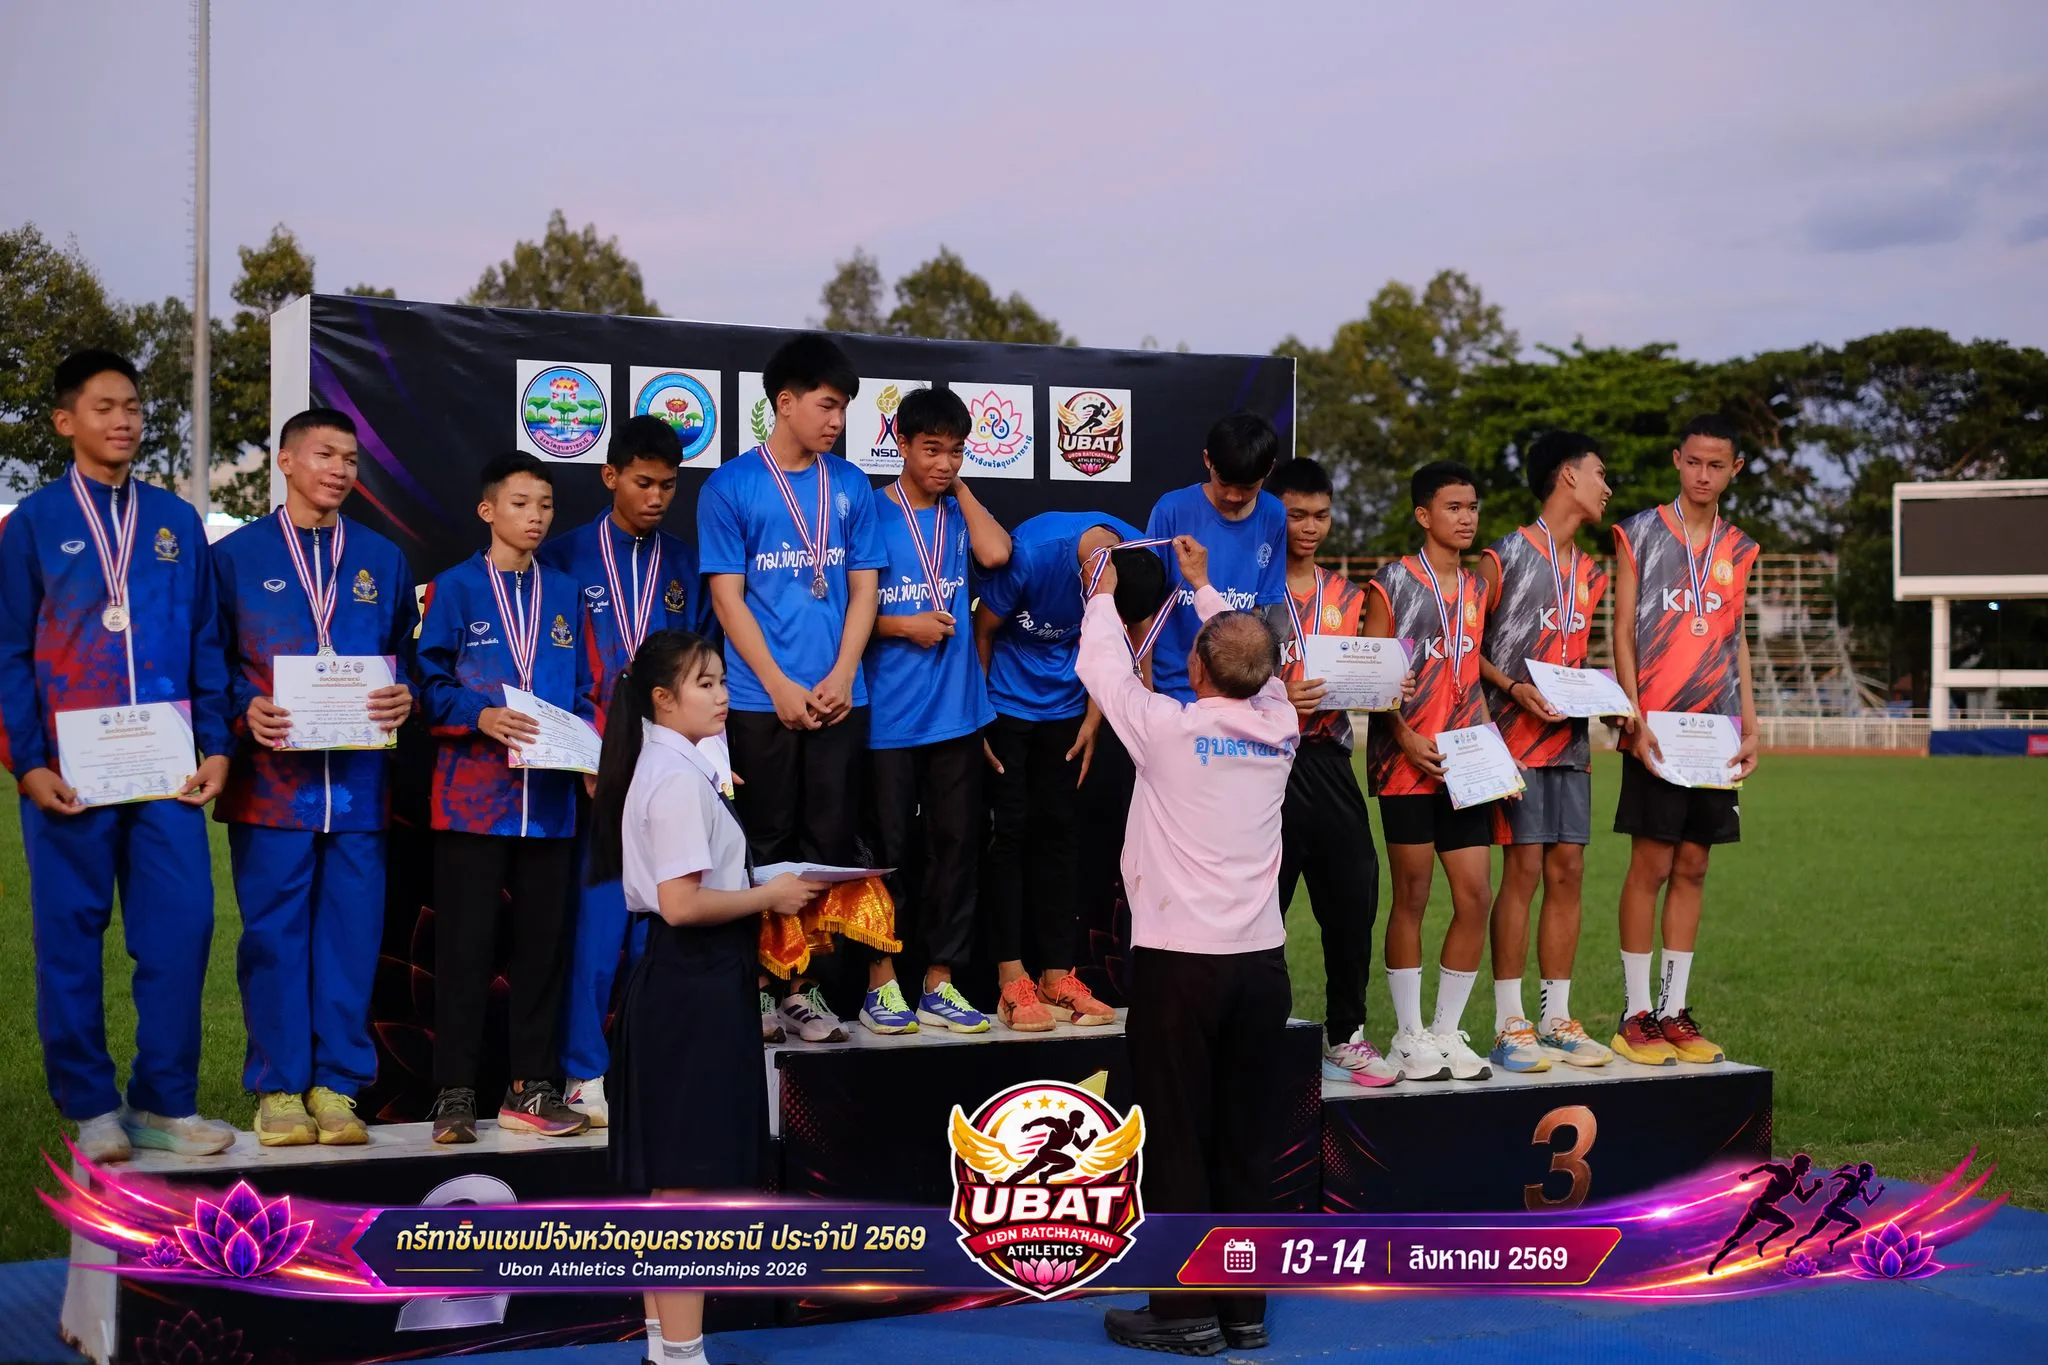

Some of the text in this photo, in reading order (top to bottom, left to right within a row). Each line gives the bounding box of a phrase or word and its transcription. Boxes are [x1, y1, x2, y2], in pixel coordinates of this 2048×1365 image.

[871, 448, 902, 458] NSD
[1063, 435, 1119, 452] UBAT
[1539, 607, 1586, 634] KP
[1524, 1105, 1598, 1213] 3
